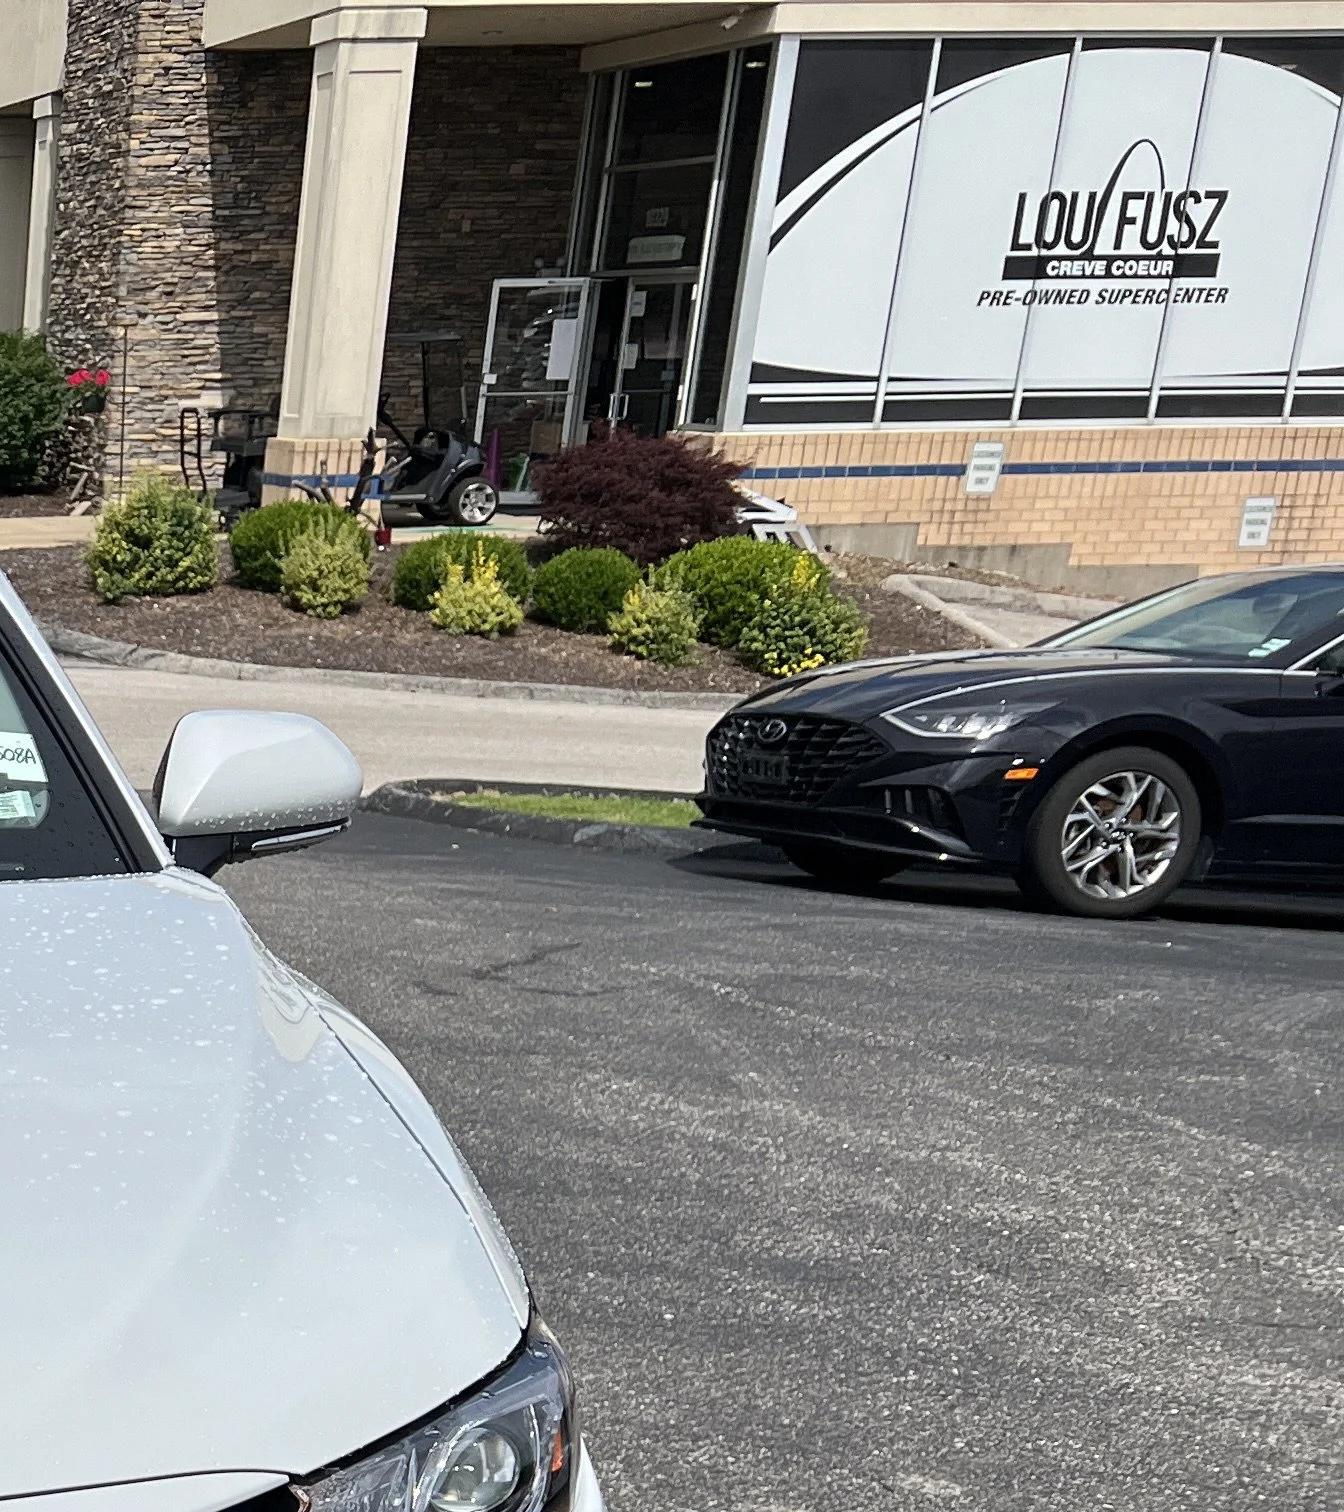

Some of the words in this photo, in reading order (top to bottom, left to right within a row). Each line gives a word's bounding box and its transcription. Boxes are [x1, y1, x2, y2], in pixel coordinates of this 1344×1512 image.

[1010, 190, 1098, 251] LOU
[1113, 189, 1229, 251] FUSZ
[1046, 260, 1107, 276] CREVE
[1111, 259, 1174, 276] COEUR
[976, 288, 1090, 307] PRE-OWNED
[1095, 287, 1230, 306] SUPERCENTER
